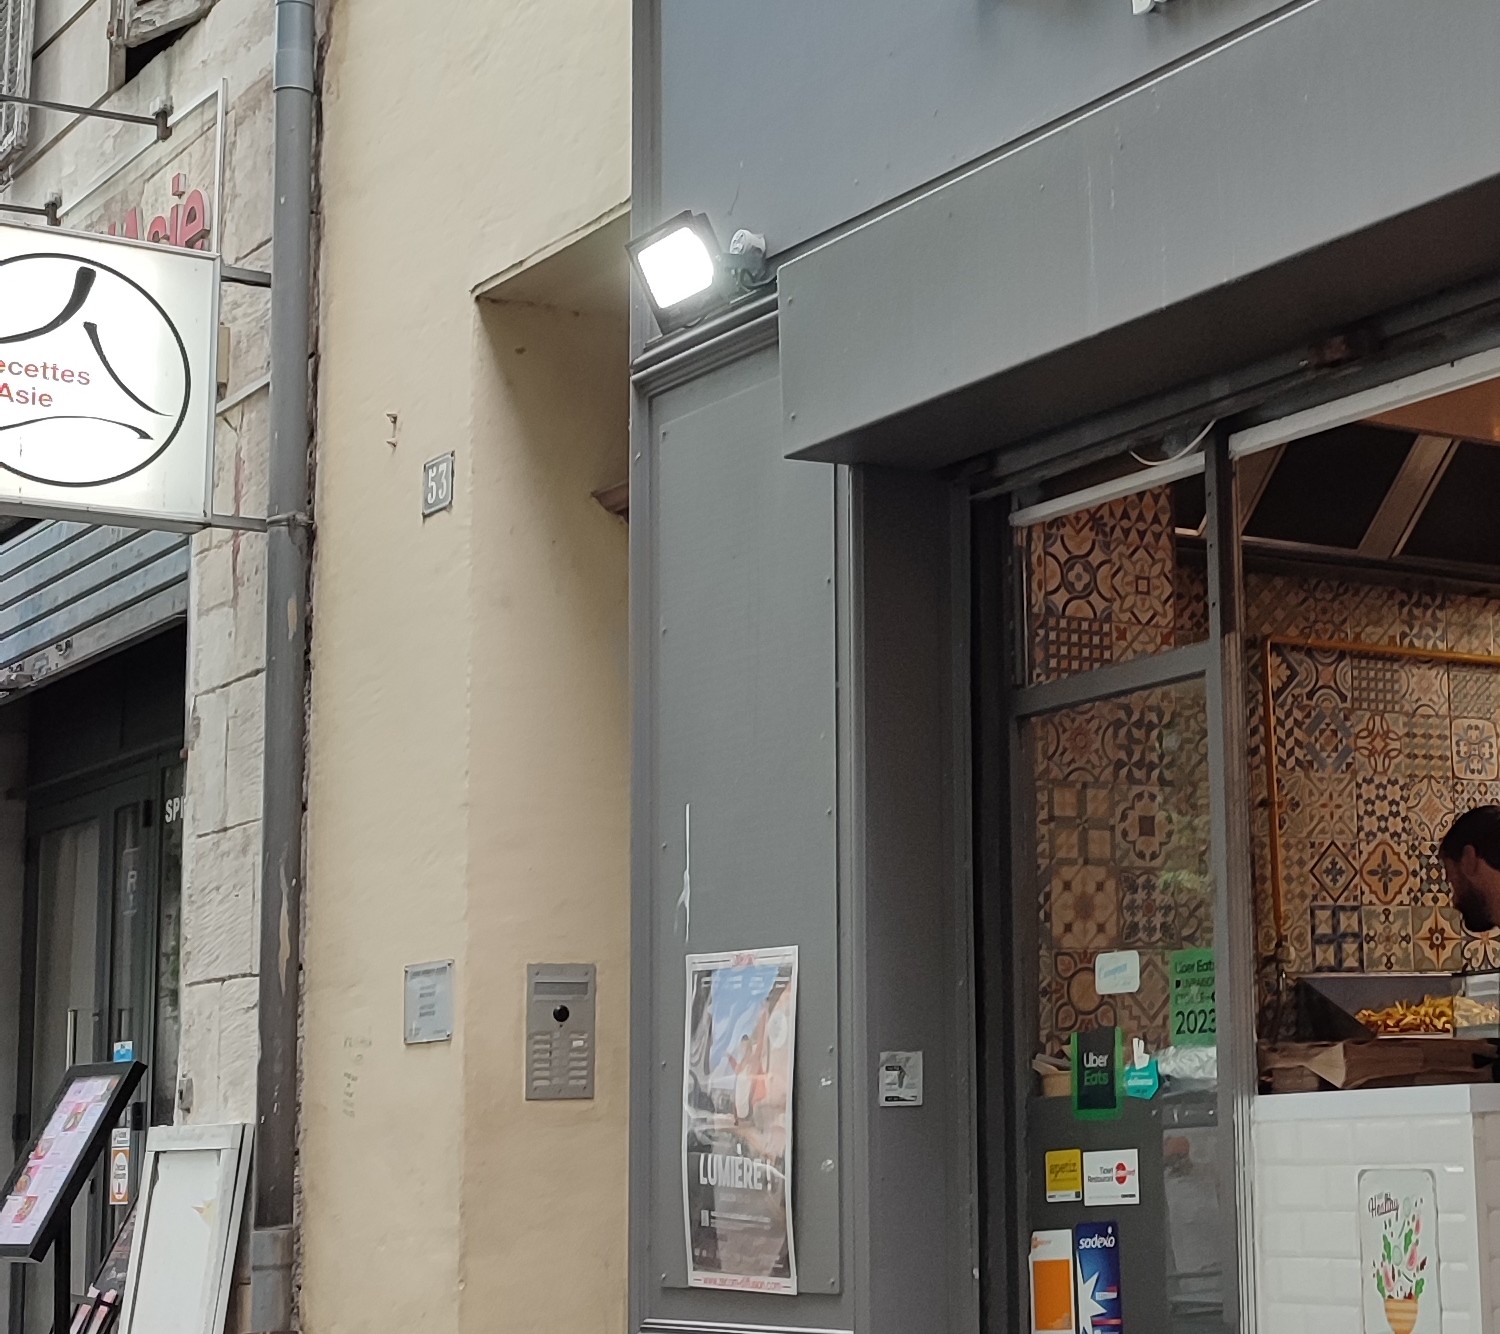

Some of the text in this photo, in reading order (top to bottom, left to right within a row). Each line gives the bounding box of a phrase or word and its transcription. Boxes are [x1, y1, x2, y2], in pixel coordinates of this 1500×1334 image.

[427, 462, 447, 504] 53
[1175, 1008, 1216, 1035] 2023
[1083, 1052, 1110, 1068] Uber
[1083, 1070, 1110, 1086] Eats
[699, 1143, 763, 1191] LUMIÈRE
[1078, 1232, 1116, 1250] sodexo
